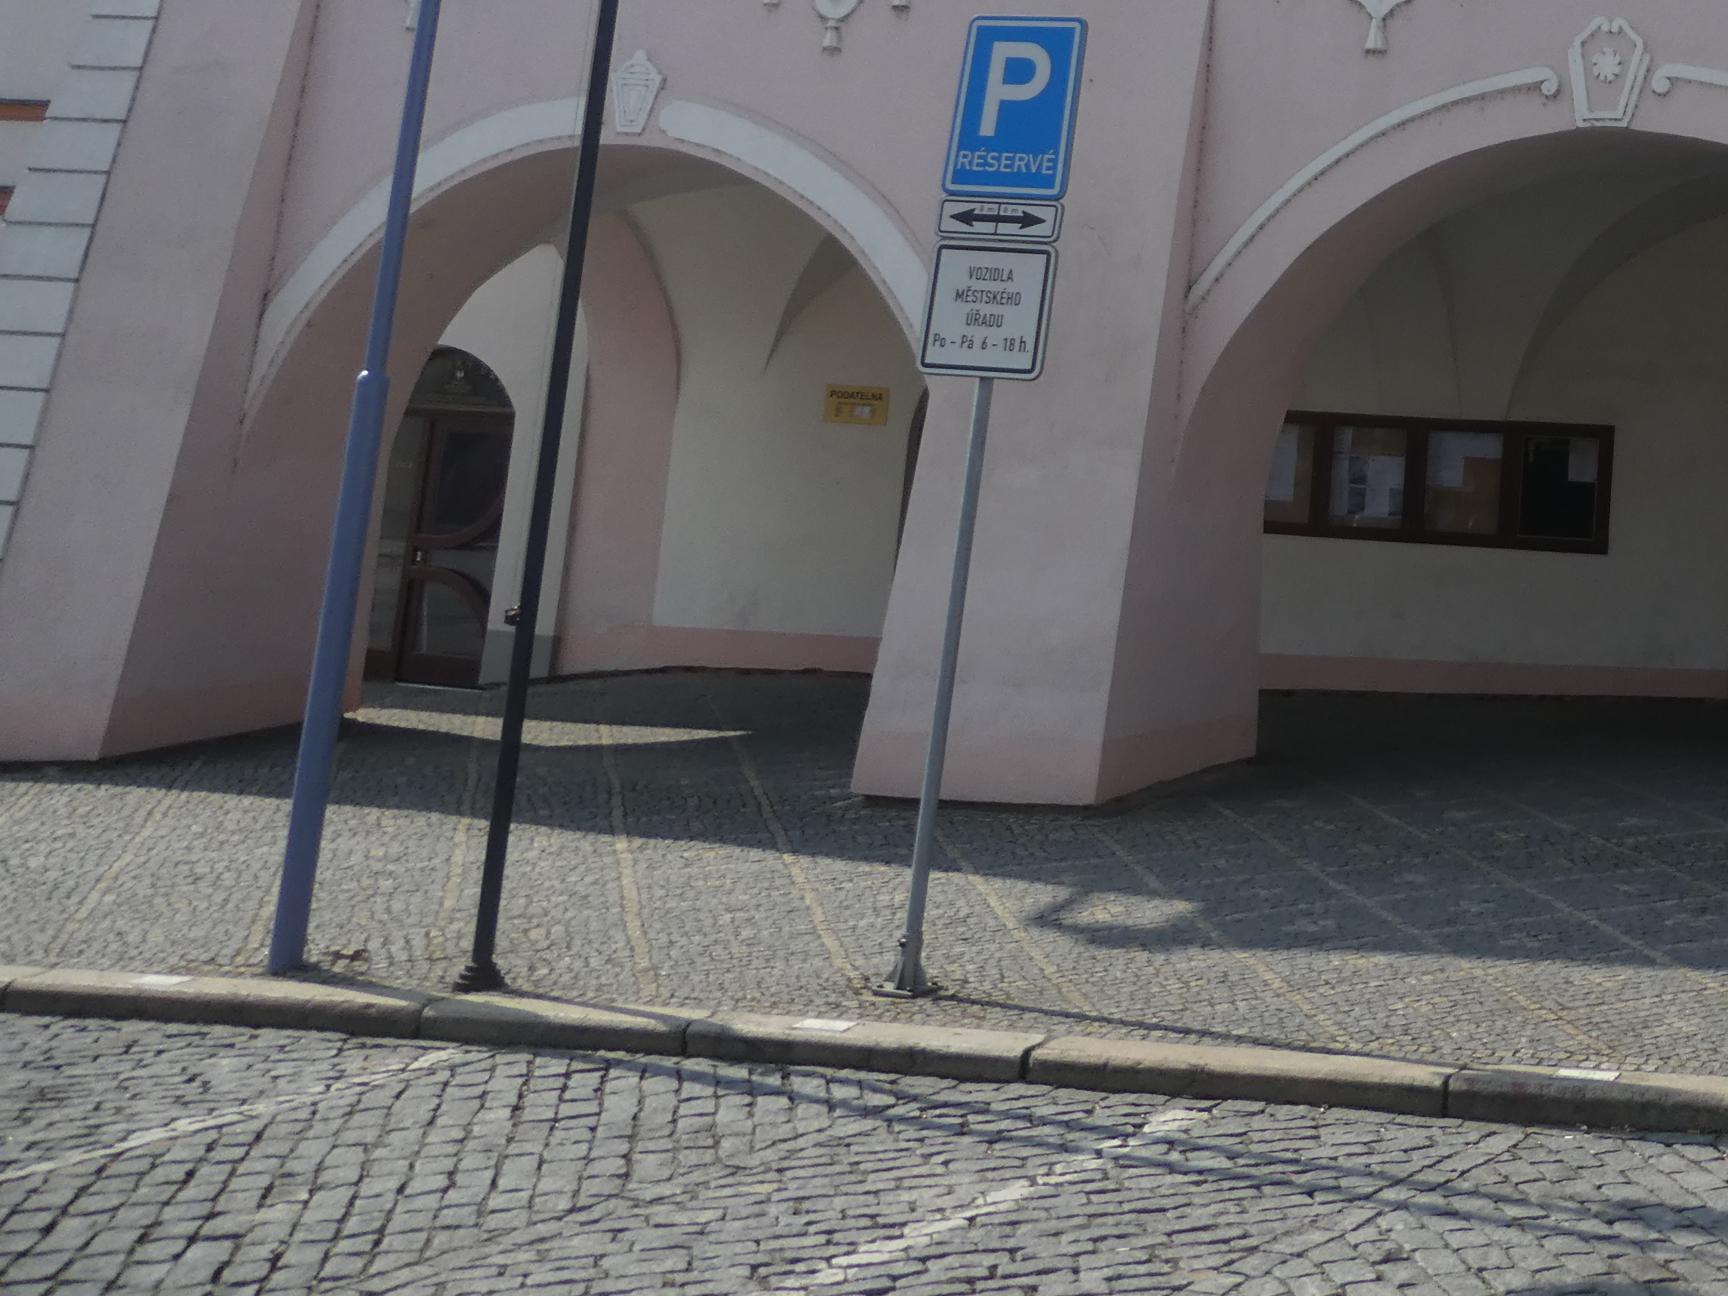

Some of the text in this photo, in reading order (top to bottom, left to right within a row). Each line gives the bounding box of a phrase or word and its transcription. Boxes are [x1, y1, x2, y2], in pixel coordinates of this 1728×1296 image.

[977, 41, 1051, 137] P
[956, 147, 1056, 174] RÉSERVÉ
[968, 265, 1014, 283] VOZIDLA
[954, 285, 1022, 306] MĚSTSKÉHO
[965, 308, 1004, 328] ÚŘADU
[932, 332, 946, 348] Po
